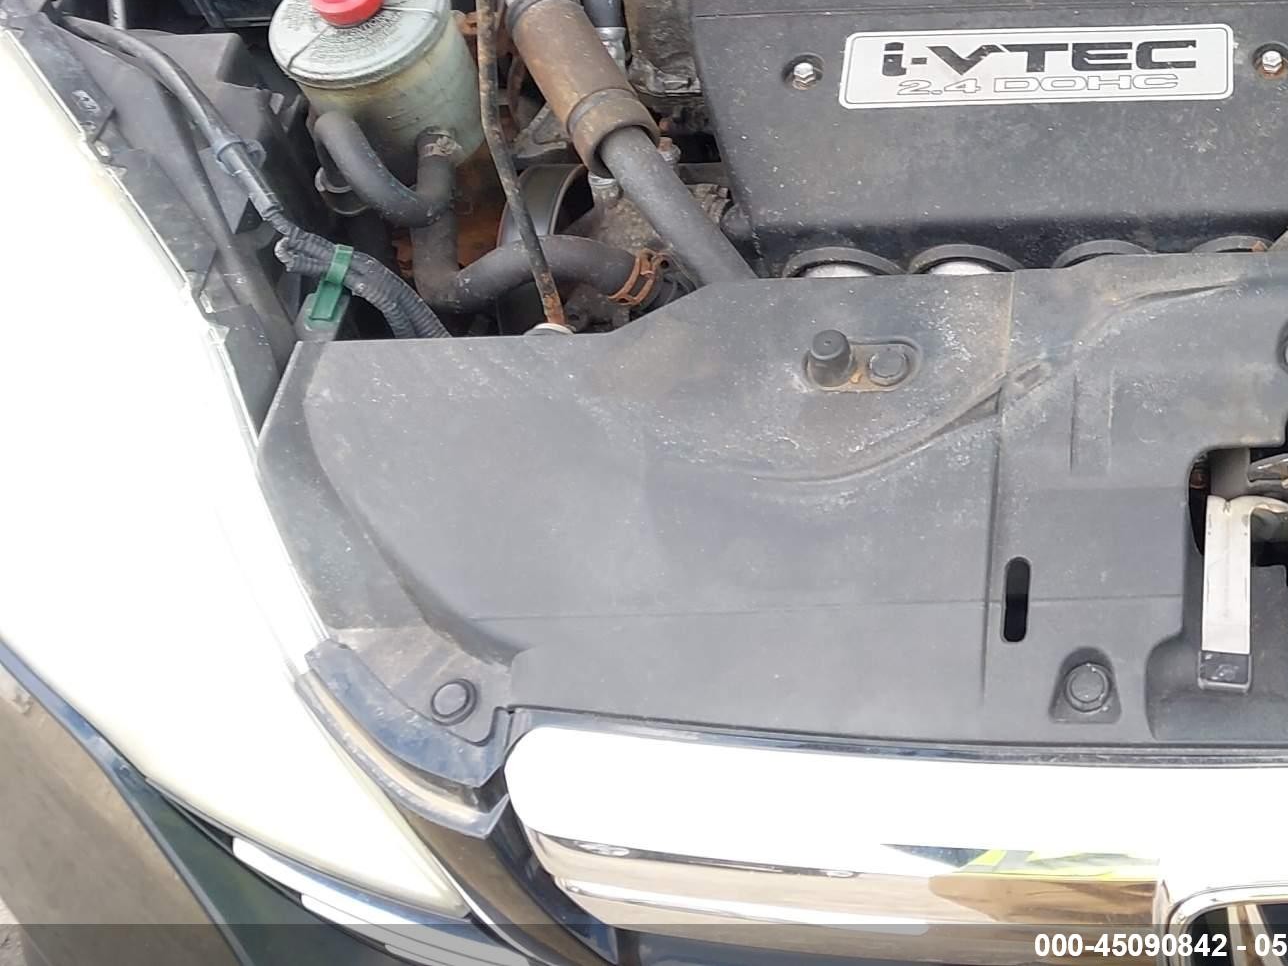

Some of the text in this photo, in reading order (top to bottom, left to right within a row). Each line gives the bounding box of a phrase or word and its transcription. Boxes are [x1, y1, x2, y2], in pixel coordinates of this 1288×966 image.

[882, 40, 1197, 77] i-VTEC
[896, 73, 1179, 96] 2.4 DOHC
